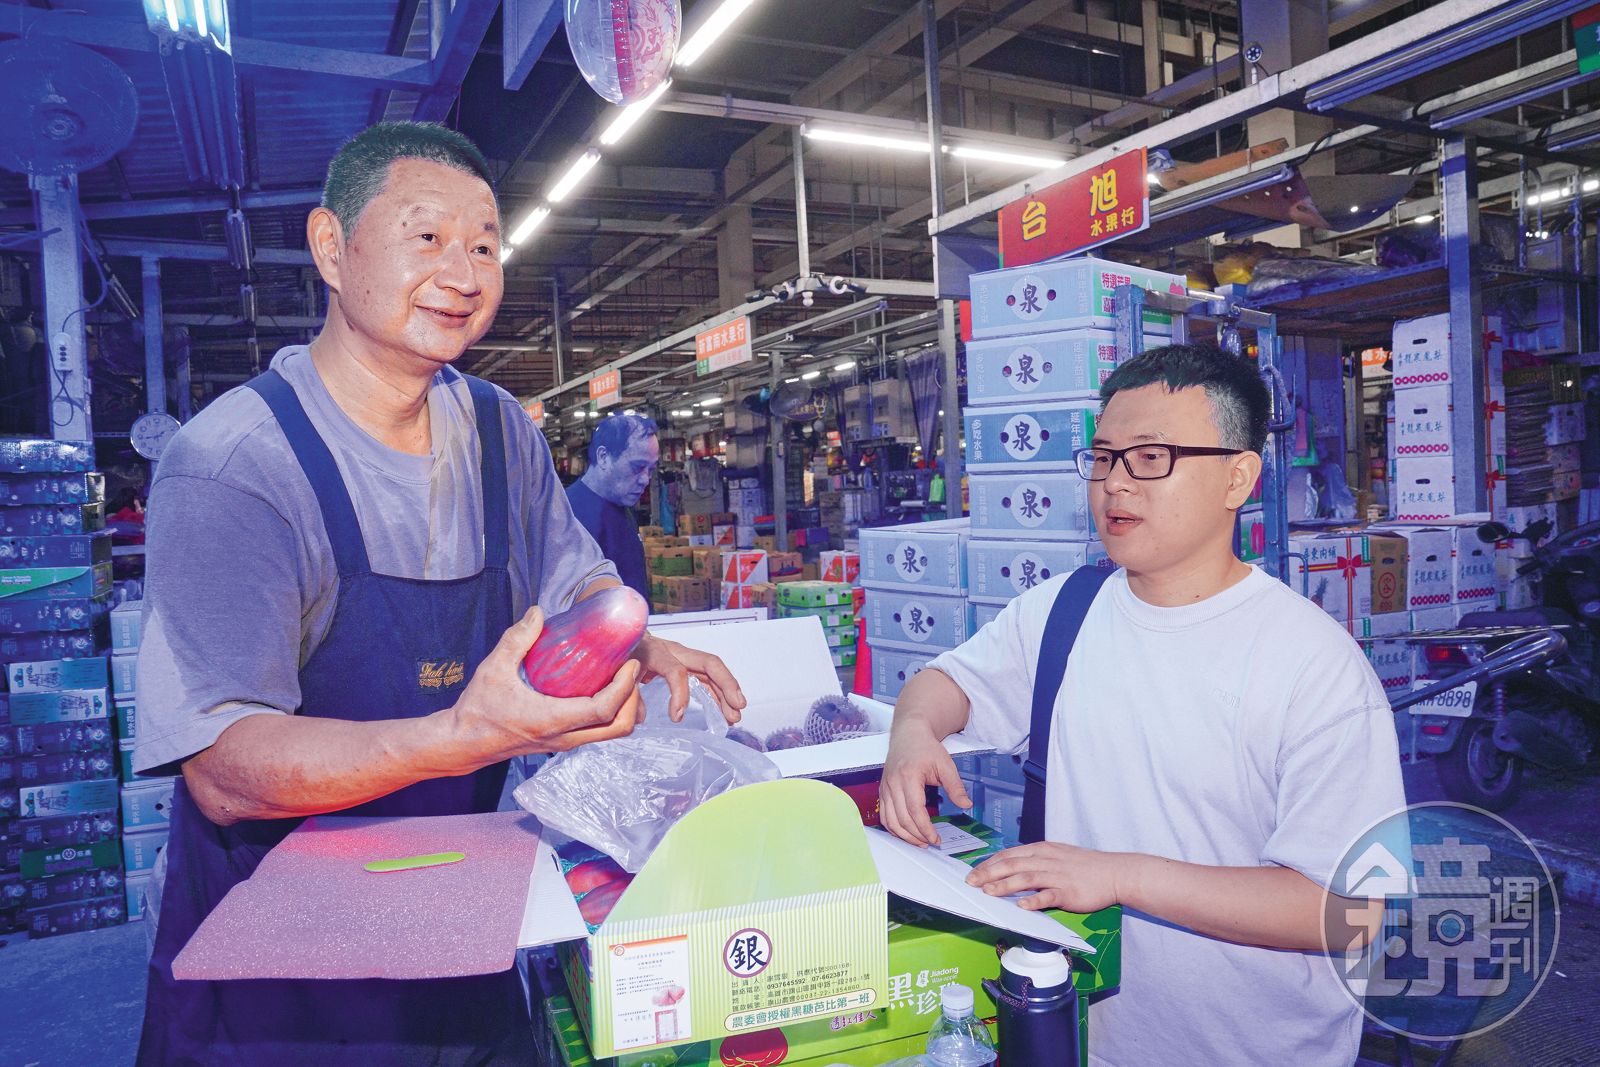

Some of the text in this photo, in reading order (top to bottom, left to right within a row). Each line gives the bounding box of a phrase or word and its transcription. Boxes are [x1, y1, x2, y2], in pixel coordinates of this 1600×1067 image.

[1021, 168, 1120, 242] 台 旭
[1090, 206, 1136, 237] 水果行
[1020, 283, 1043, 314] 泉
[1015, 354, 1039, 385] 泉
[972, 419, 984, 461] 多吃水果
[1012, 421, 1036, 452] 泉
[1070, 411, 1082, 451] 延年益
[1019, 488, 1043, 519] 泉
[902, 546, 921, 574] 泉
[1018, 559, 1038, 589] 泉
[908, 607, 928, 634] 泉
[1417, 690, 1472, 708] -8898
[729, 935, 768, 971] 銀
